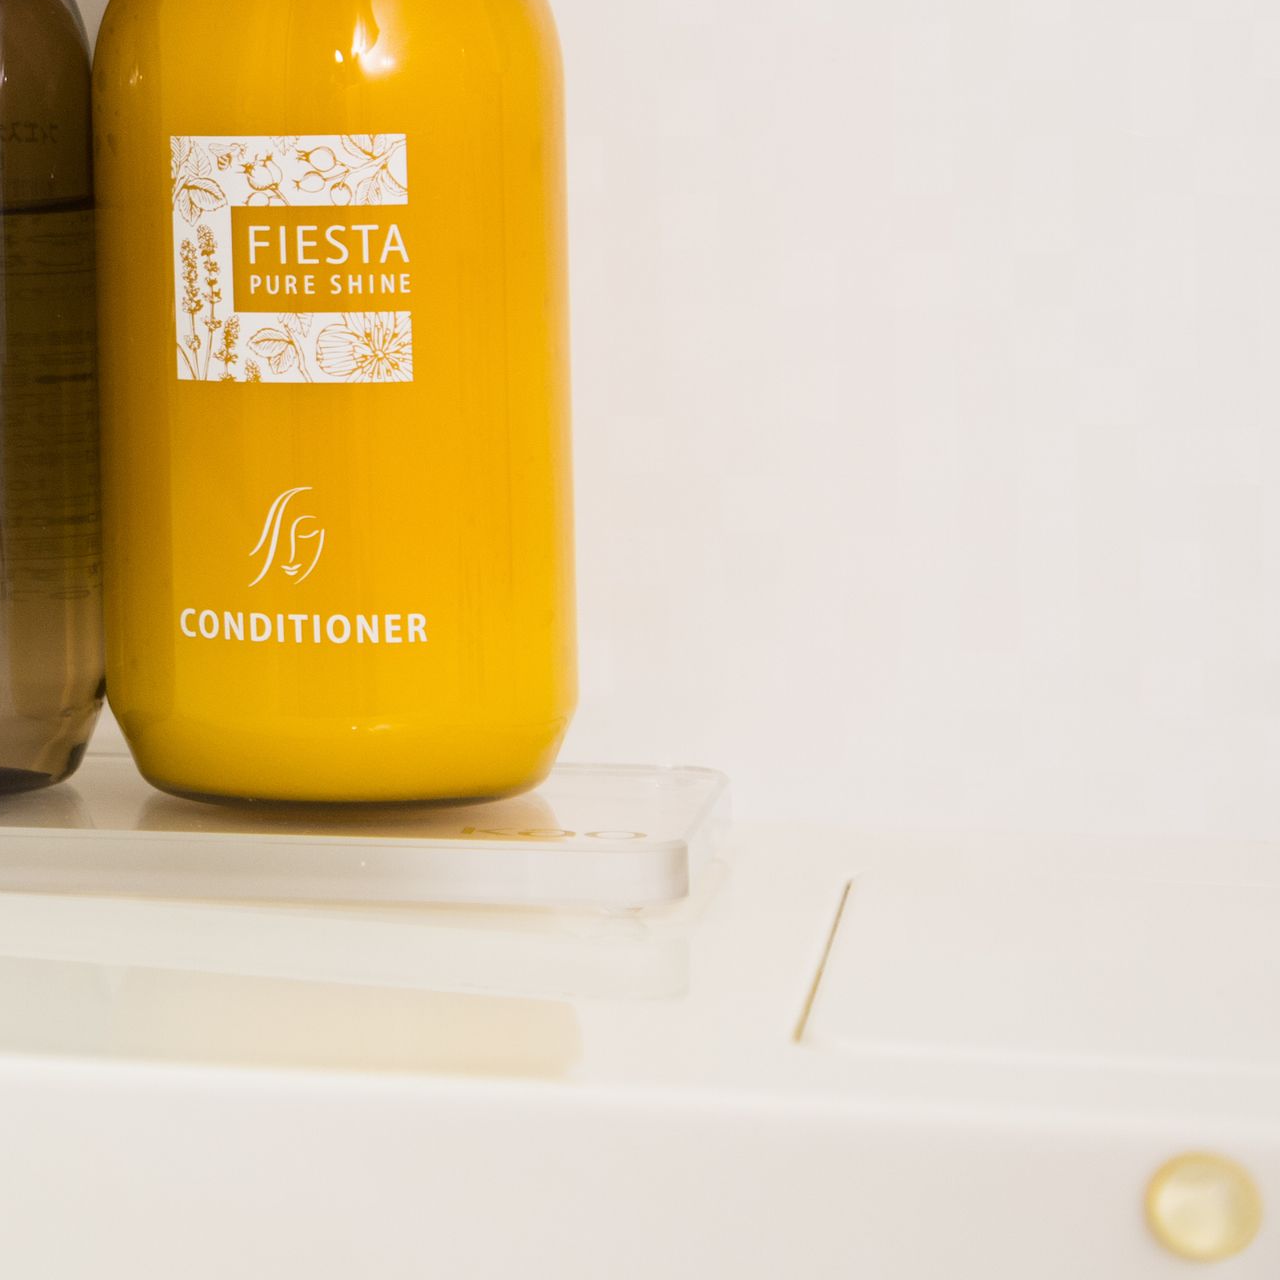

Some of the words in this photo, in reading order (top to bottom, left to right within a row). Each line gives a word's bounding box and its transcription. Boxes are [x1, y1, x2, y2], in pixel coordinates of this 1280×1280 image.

[249, 224, 410, 264] FIESTA
[251, 275, 315, 294] PURE
[331, 273, 410, 294] SHINE
[182, 609, 428, 643] CONDITIONER
